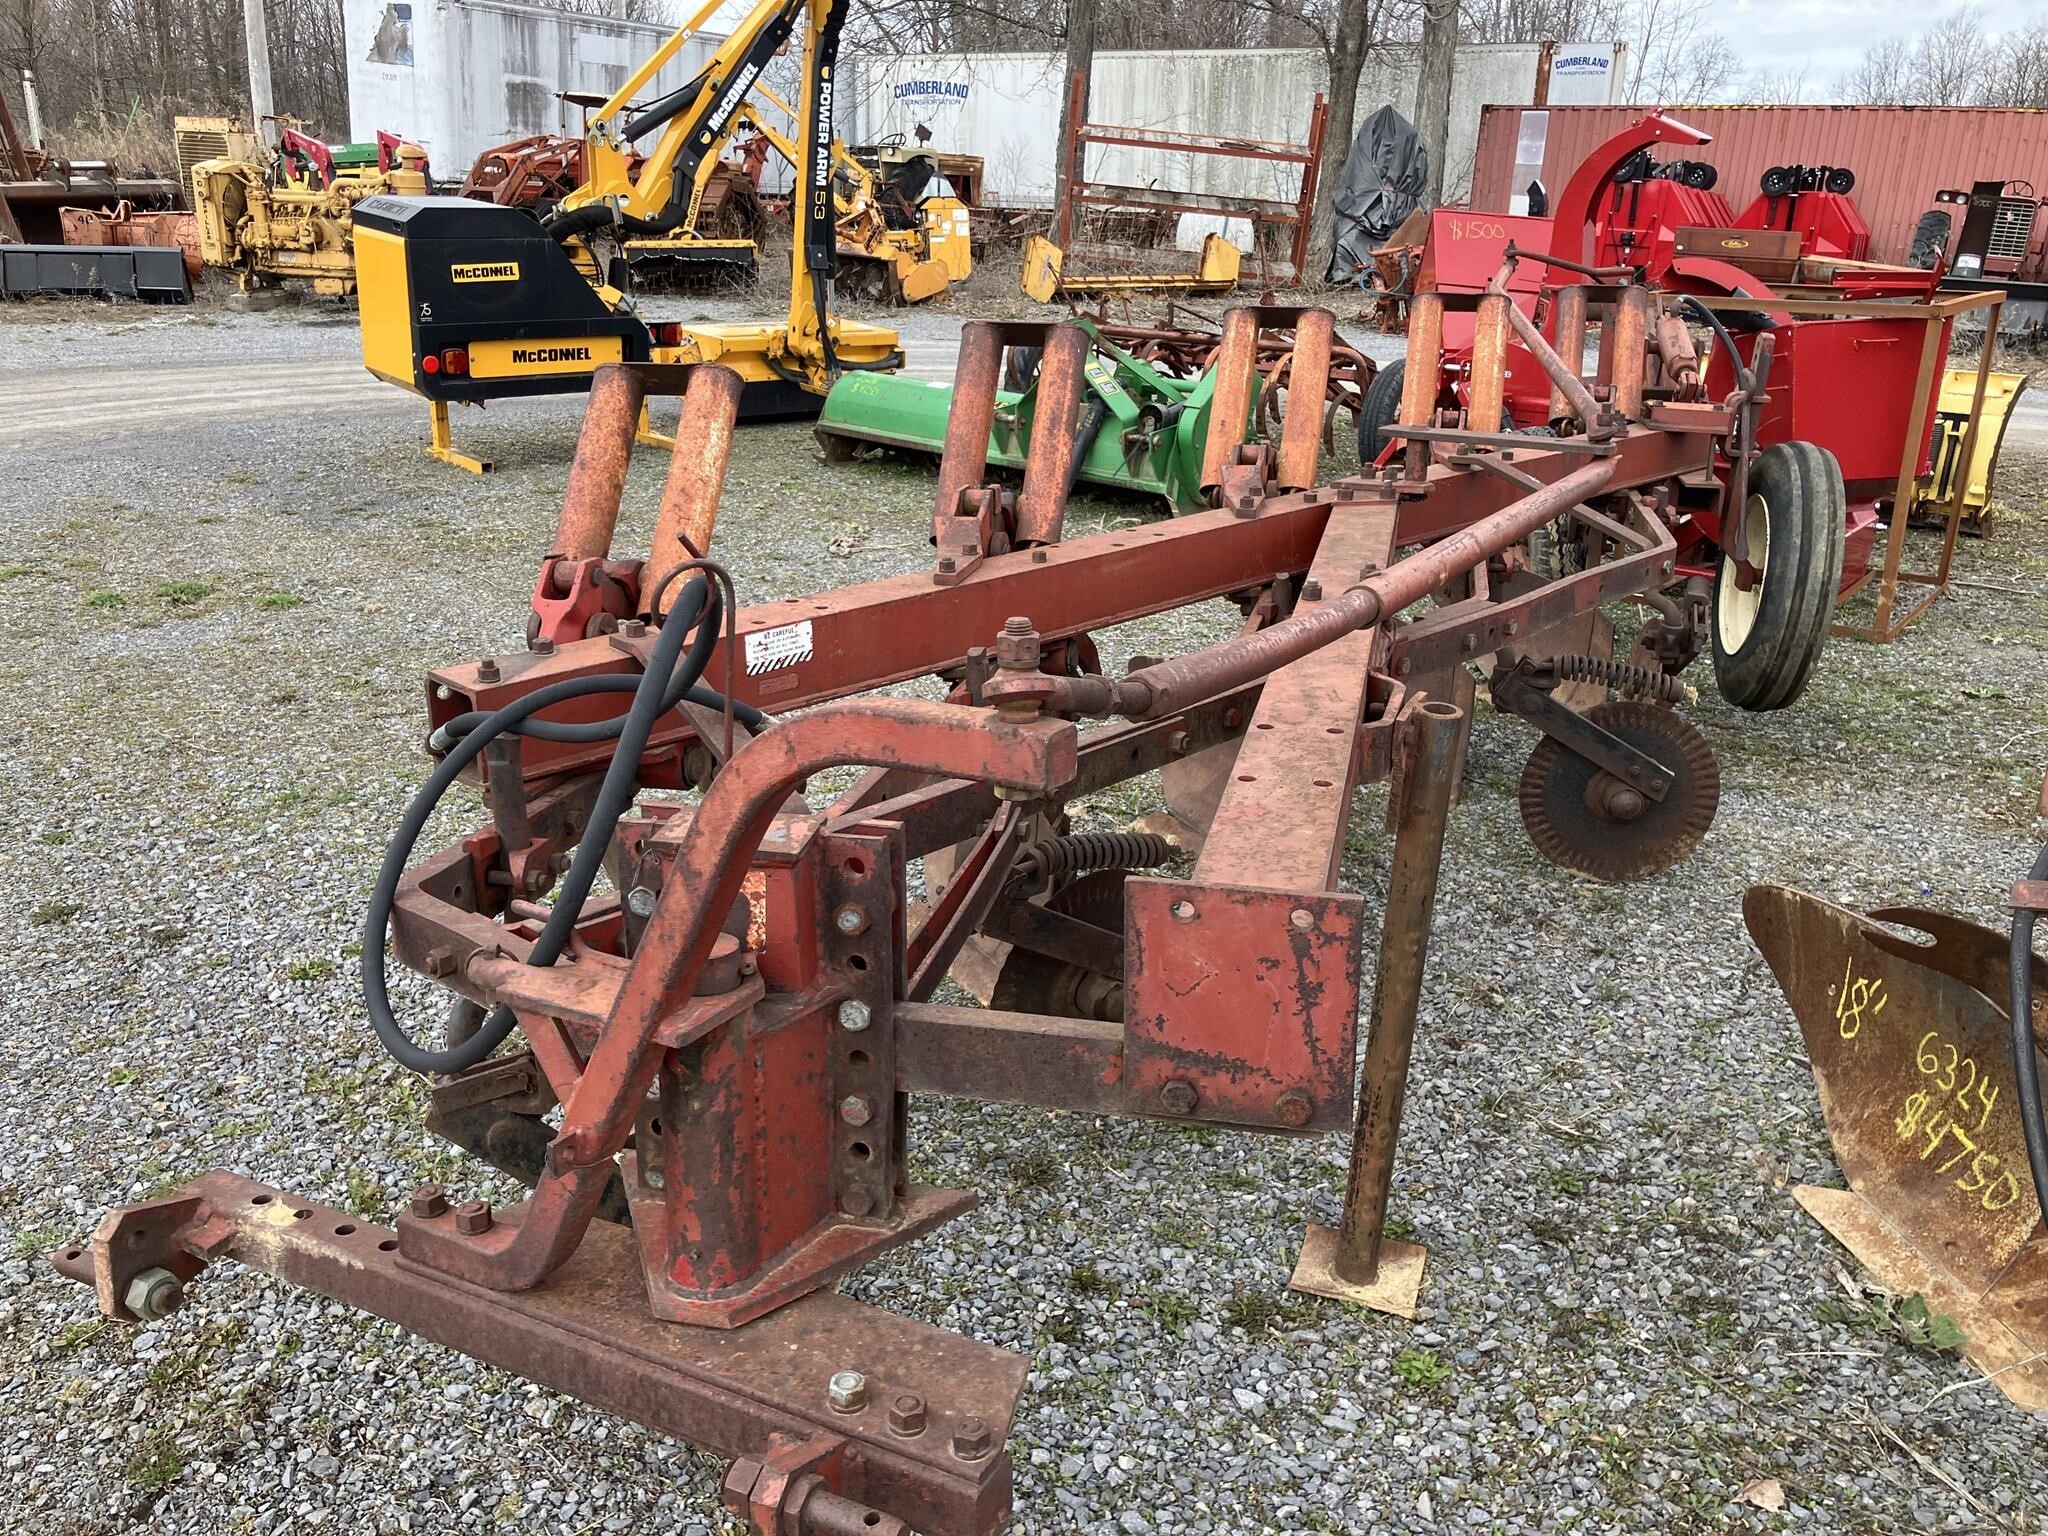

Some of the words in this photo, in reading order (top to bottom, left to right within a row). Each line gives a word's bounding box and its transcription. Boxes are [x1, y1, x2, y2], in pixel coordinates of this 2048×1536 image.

[1556, 56, 1608, 70] CUMBERLAND
[894, 81, 969, 98] CUMBERLAND
[818, 83, 832, 144] POWER
[816, 148, 830, 186] ARM
[814, 190, 826, 220] 53
[1449, 216, 1504, 240] $1500
[1916, 1031, 1999, 1132] 6324
[1895, 1088, 2020, 1211] $4750
